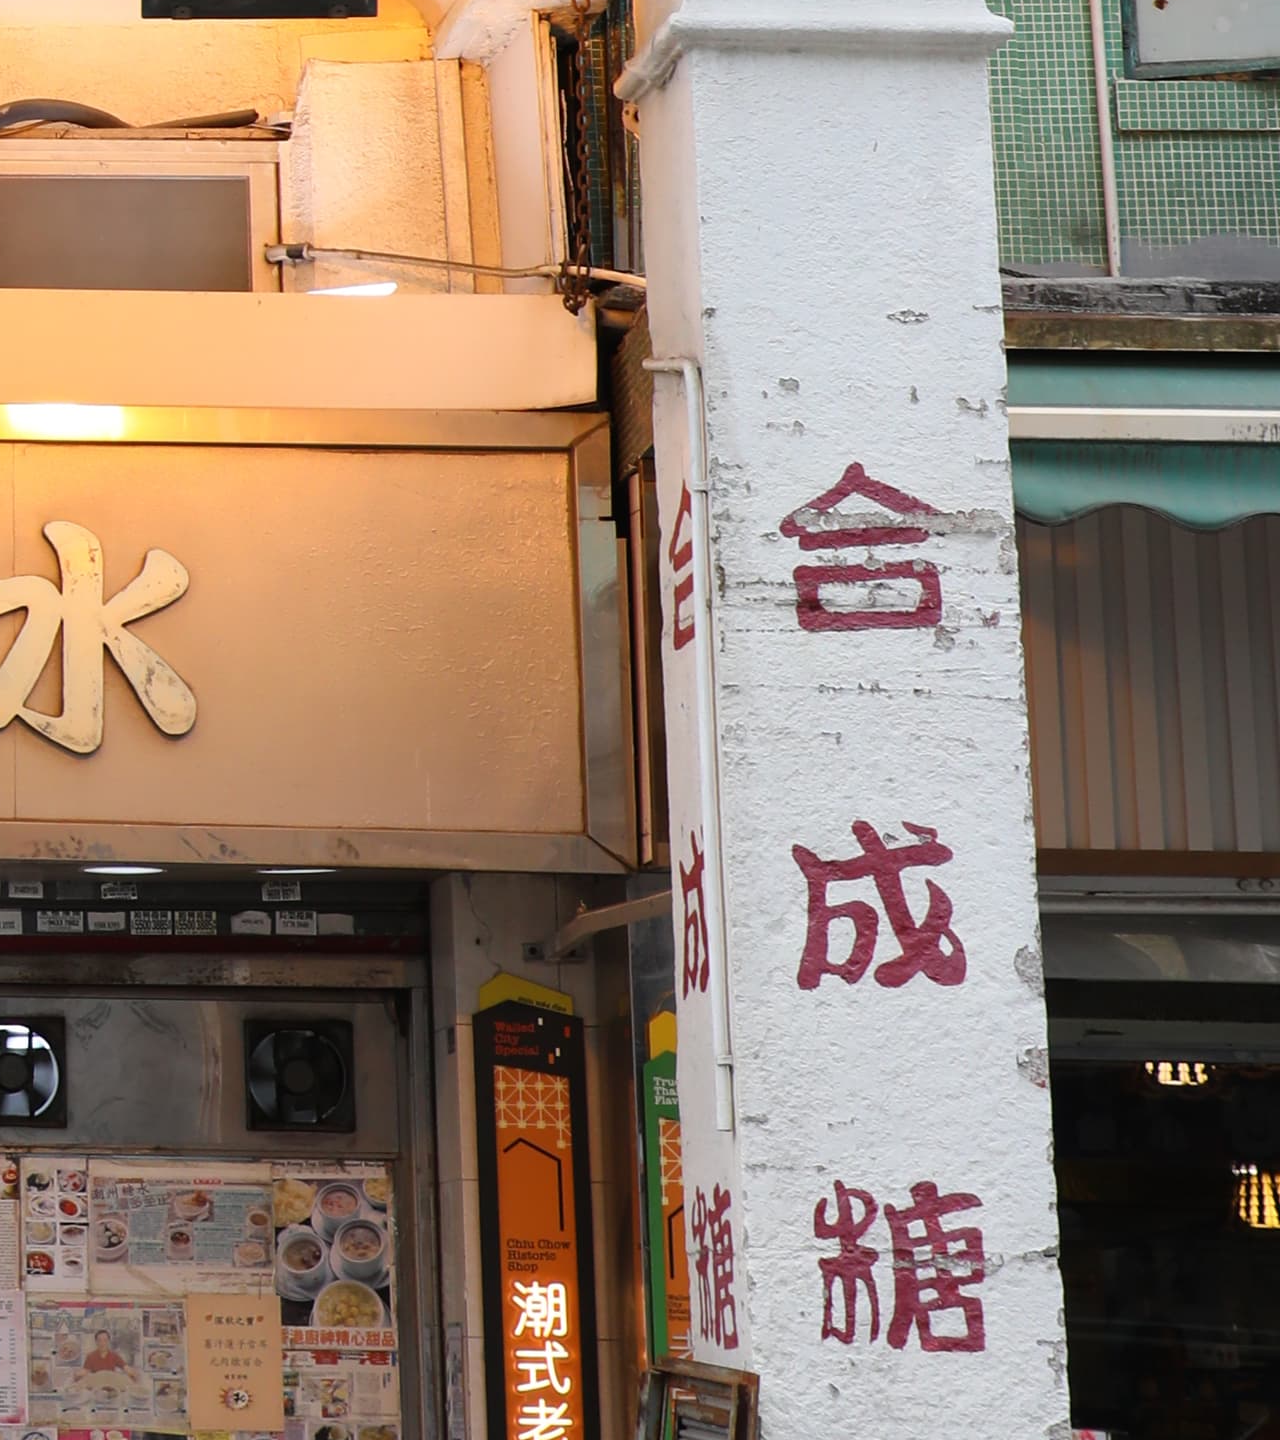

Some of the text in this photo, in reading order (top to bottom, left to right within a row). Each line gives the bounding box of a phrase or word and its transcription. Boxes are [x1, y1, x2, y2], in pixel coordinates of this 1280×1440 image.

[496, 1022, 535, 1032] Walled
[496, 1033, 519, 1045] City
[496, 1045, 539, 1056] Special
[507, 1239, 571, 1250] Chiu Chow
[507, 1250, 557, 1261] Historic
[507, 1261, 539, 1273] Shop
